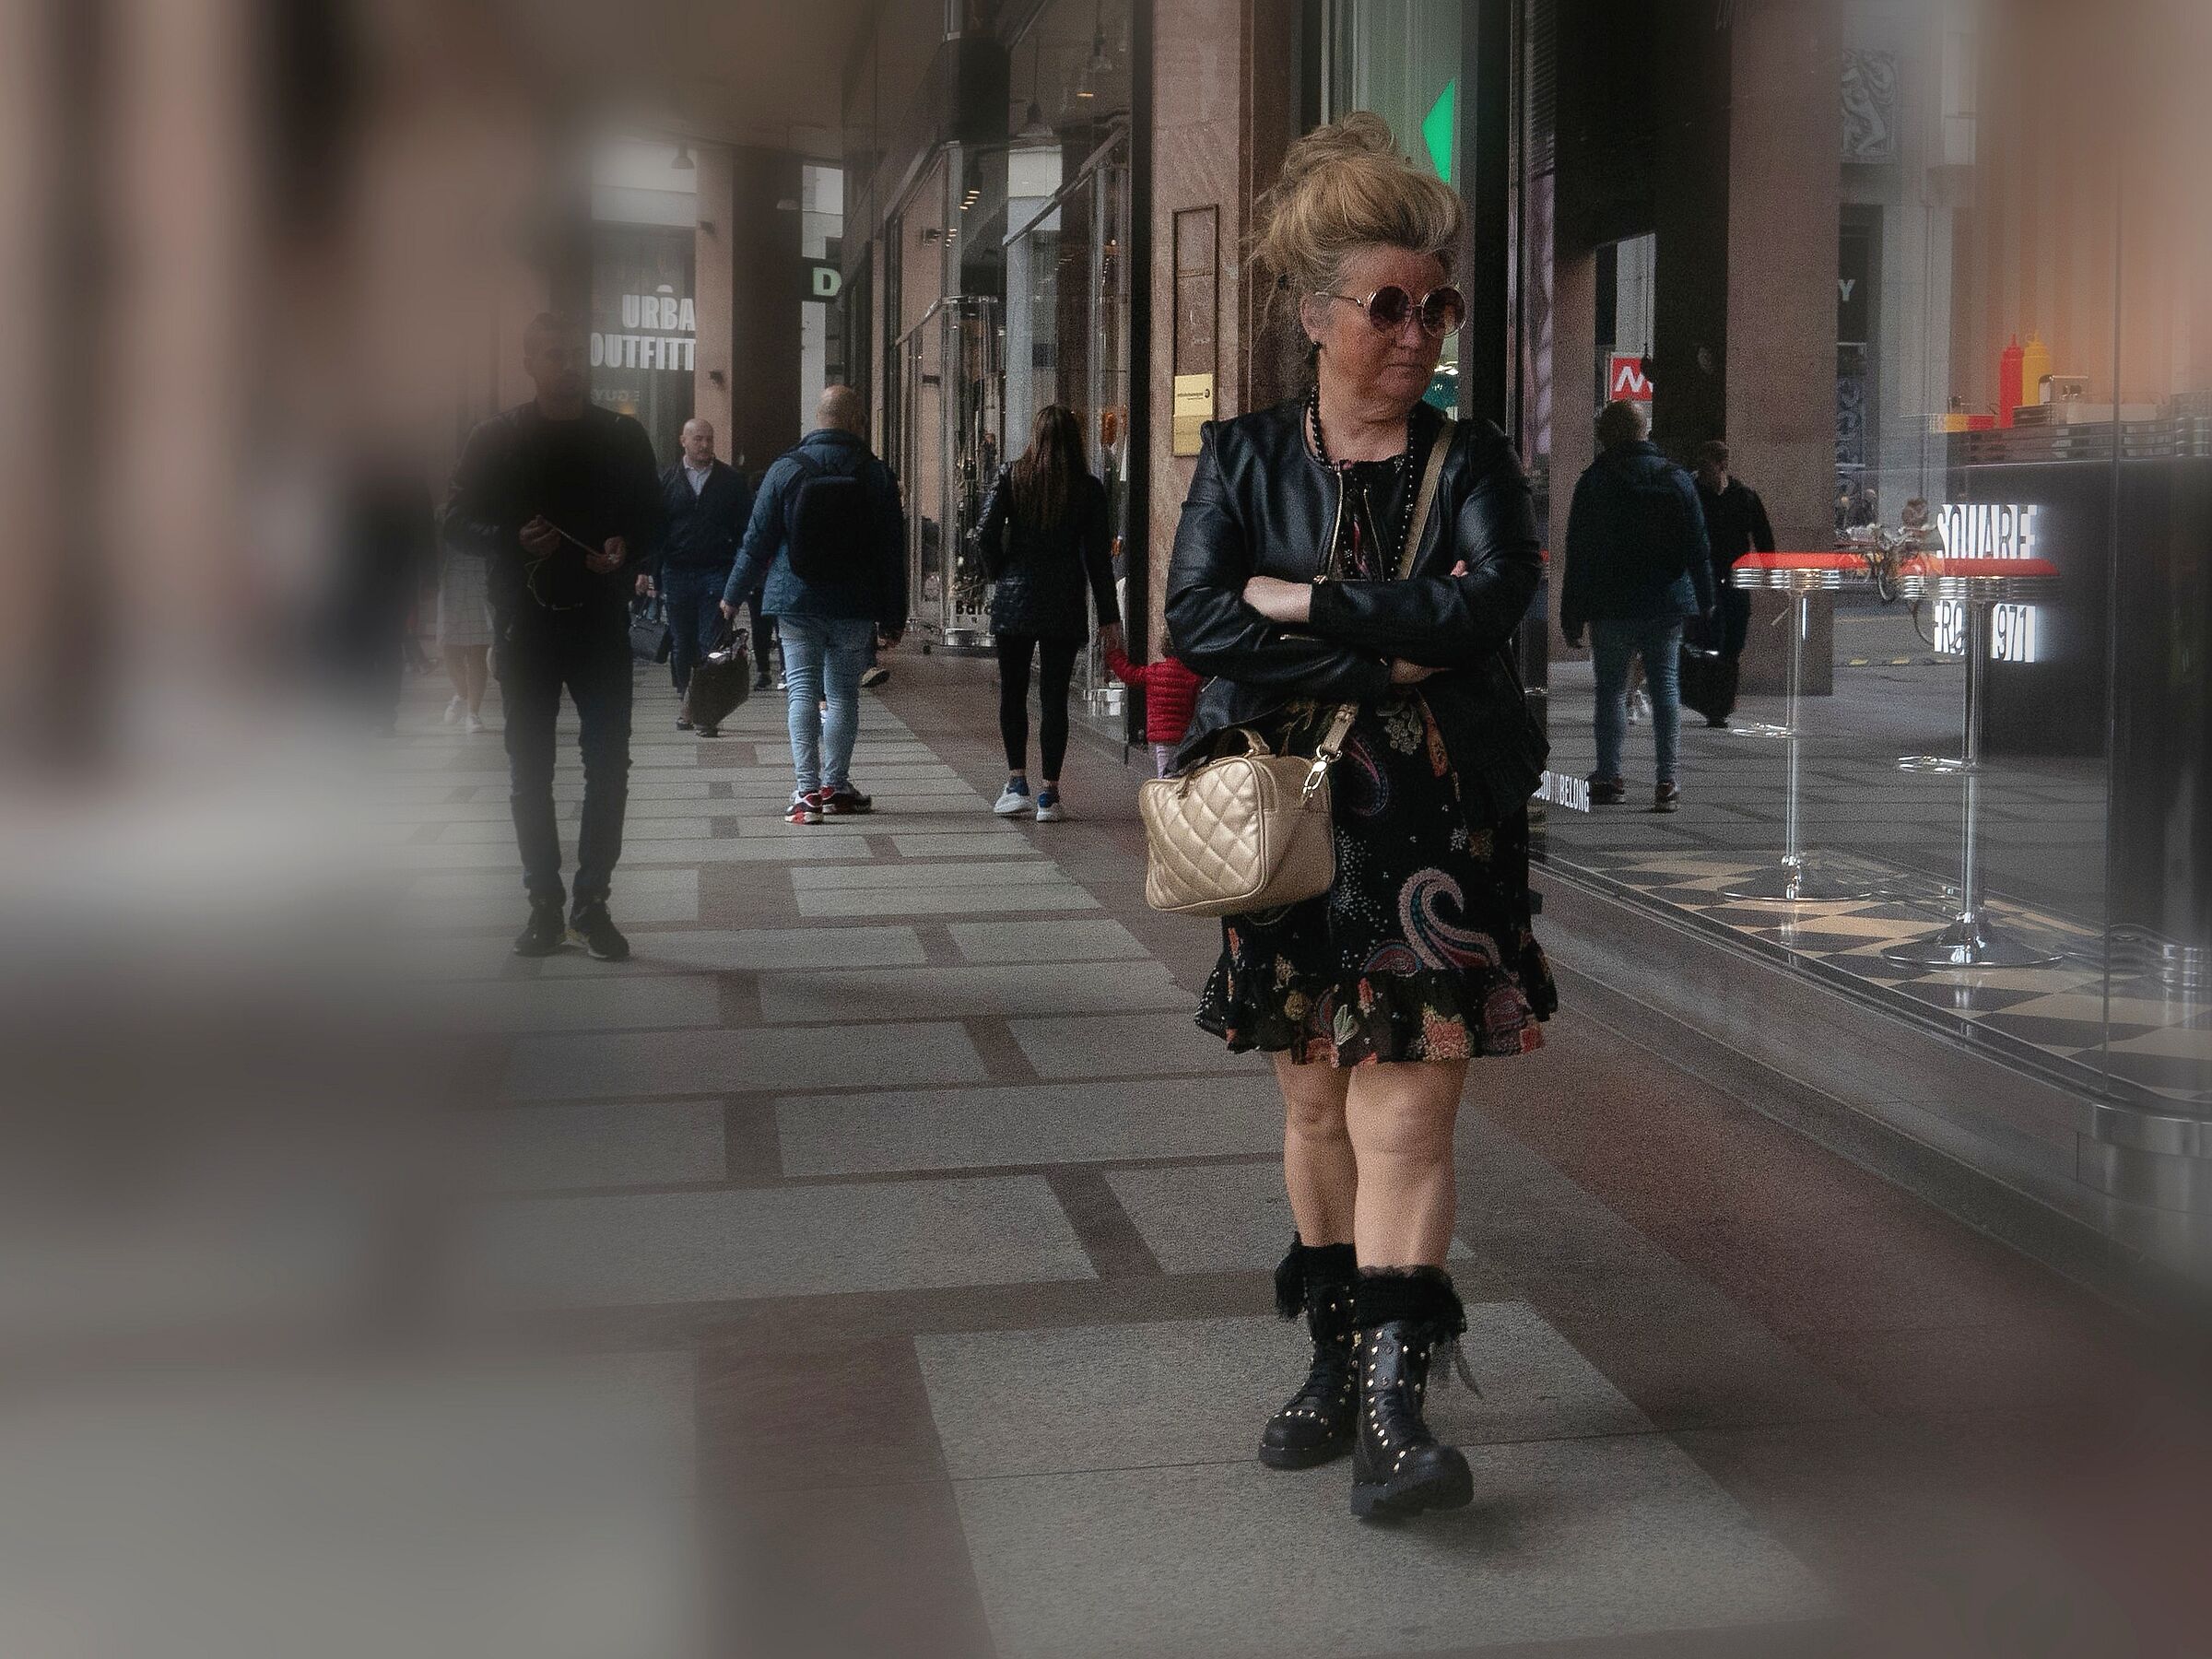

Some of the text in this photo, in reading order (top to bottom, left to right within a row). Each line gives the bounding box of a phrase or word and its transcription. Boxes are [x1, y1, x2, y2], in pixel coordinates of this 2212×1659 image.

[812, 266, 842, 297] D
[1936, 504, 2037, 559] SQUARE
[1559, 774, 1590, 813] BELONG
